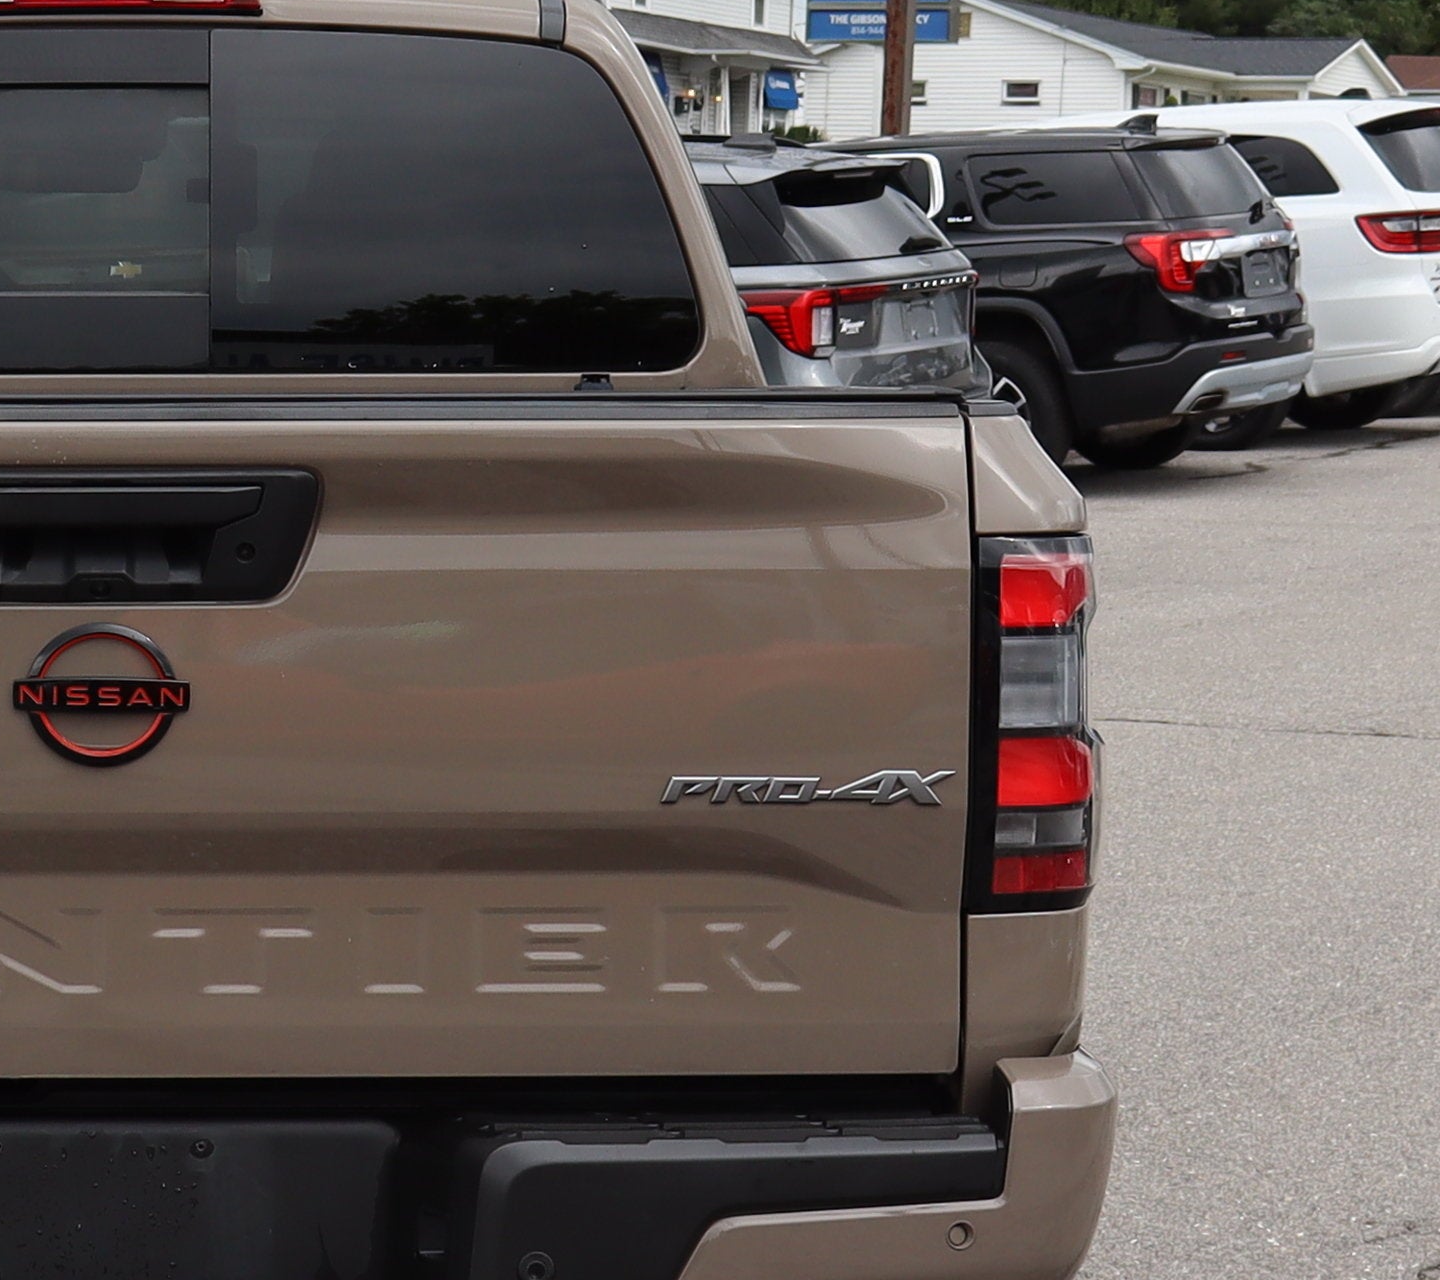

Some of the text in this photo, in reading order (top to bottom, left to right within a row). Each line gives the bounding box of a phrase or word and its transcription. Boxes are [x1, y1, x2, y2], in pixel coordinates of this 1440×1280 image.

[829, 14, 849, 24] THE
[19, 684, 185, 708] NISSAN
[660, 769, 957, 806] PRO-4X
